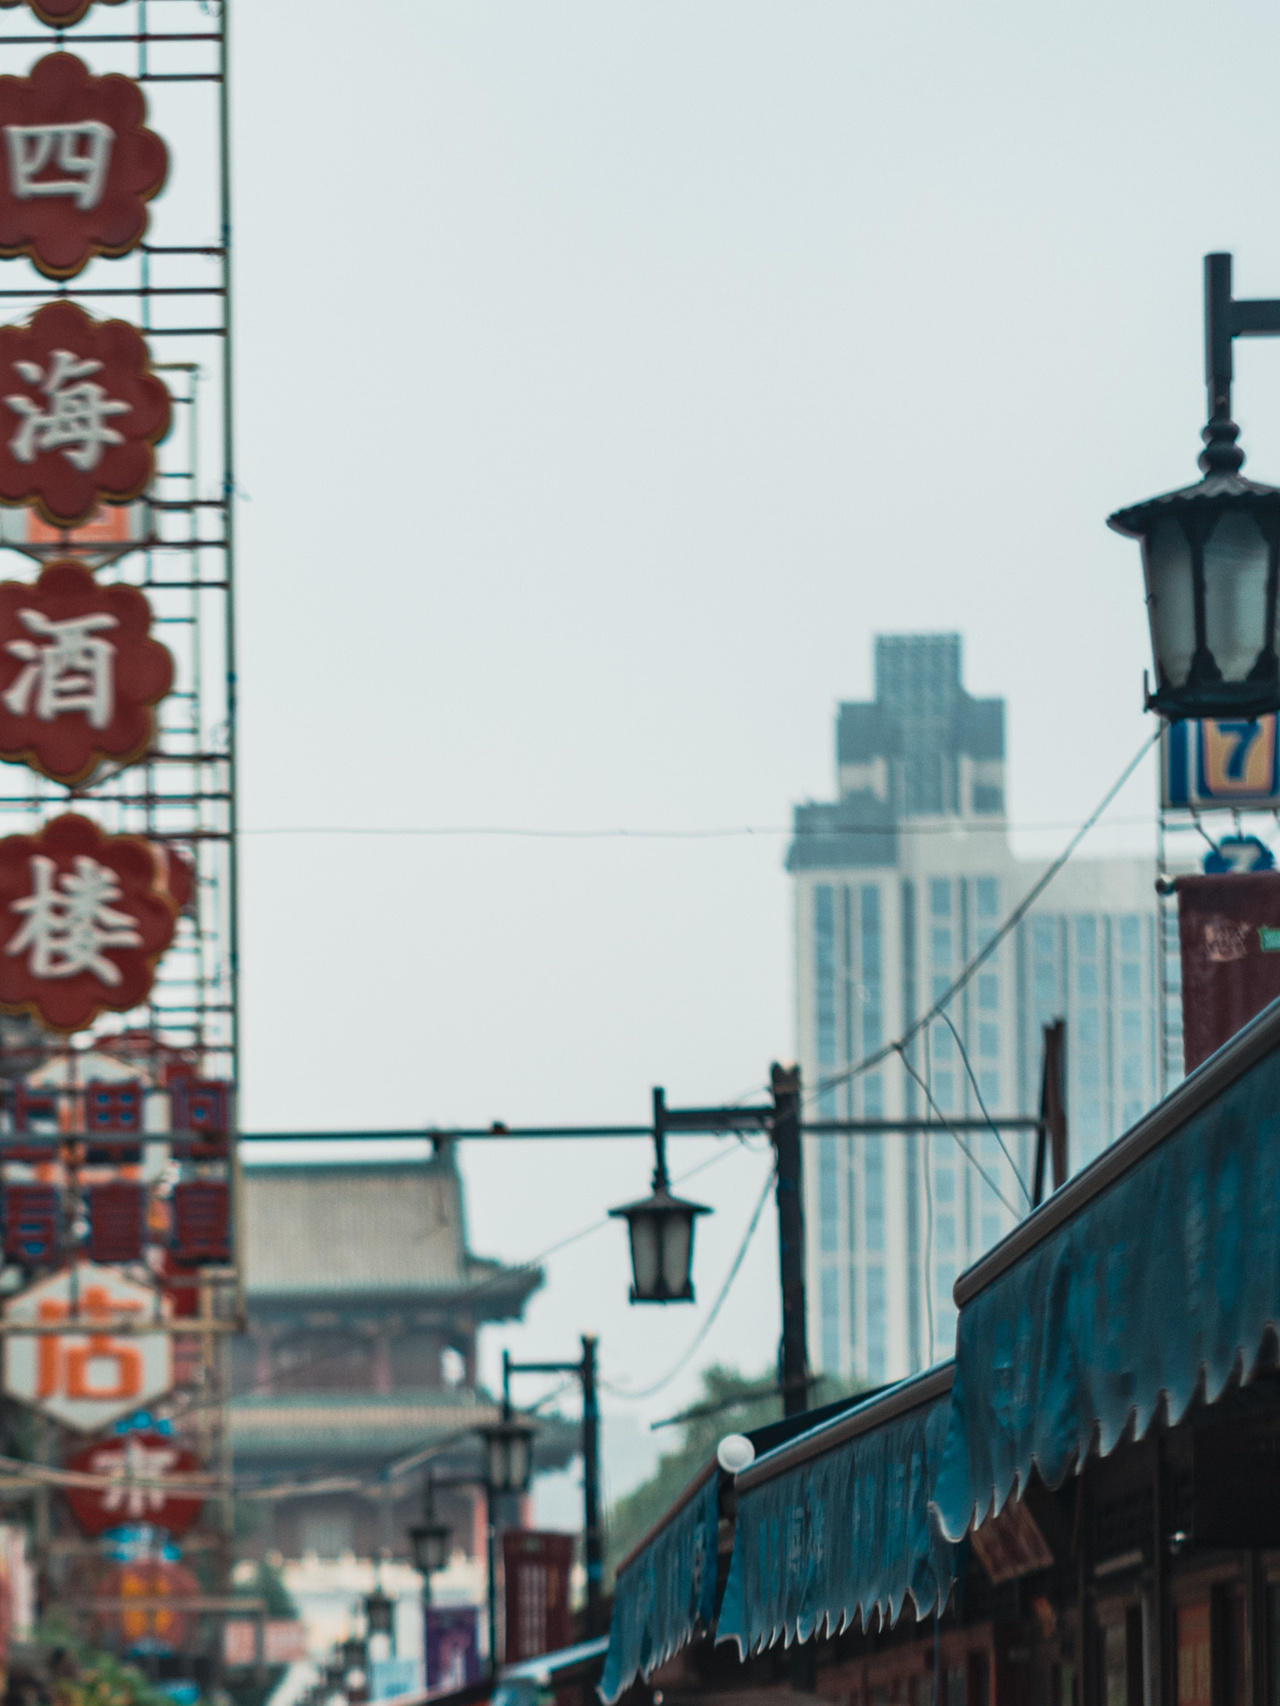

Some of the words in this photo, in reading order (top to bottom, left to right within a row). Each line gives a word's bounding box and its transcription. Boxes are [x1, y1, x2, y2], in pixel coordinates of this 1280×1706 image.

[2, 120, 145, 988] 四海酒楼
[1218, 721, 1261, 781] 7
